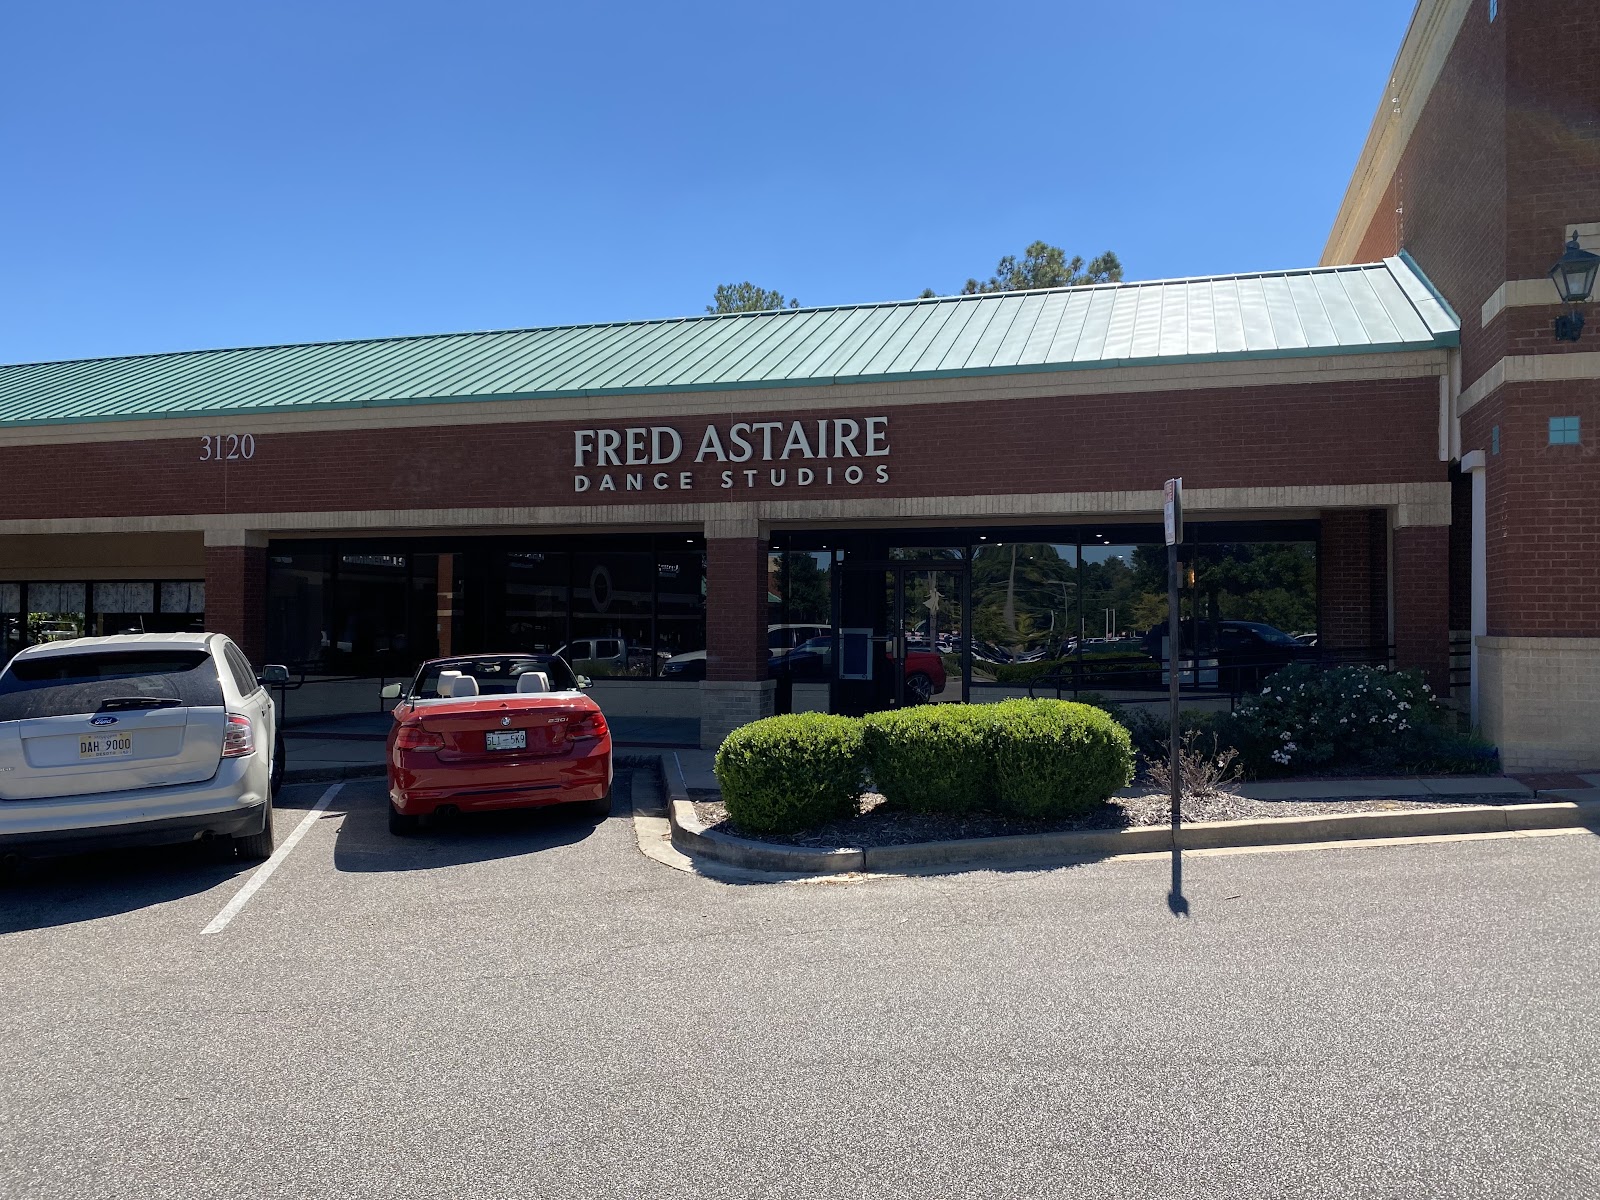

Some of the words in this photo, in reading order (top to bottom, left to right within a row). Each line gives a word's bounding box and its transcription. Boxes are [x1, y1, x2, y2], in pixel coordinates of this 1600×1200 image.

[200, 433, 255, 461] 3120
[573, 426, 683, 467] FRED
[694, 416, 890, 463] ASTAIRE
[574, 471, 693, 492] DANCE
[720, 464, 890, 489] STUDIOS
[80, 741, 100, 753] DAH
[106, 738, 130, 750] 9000
